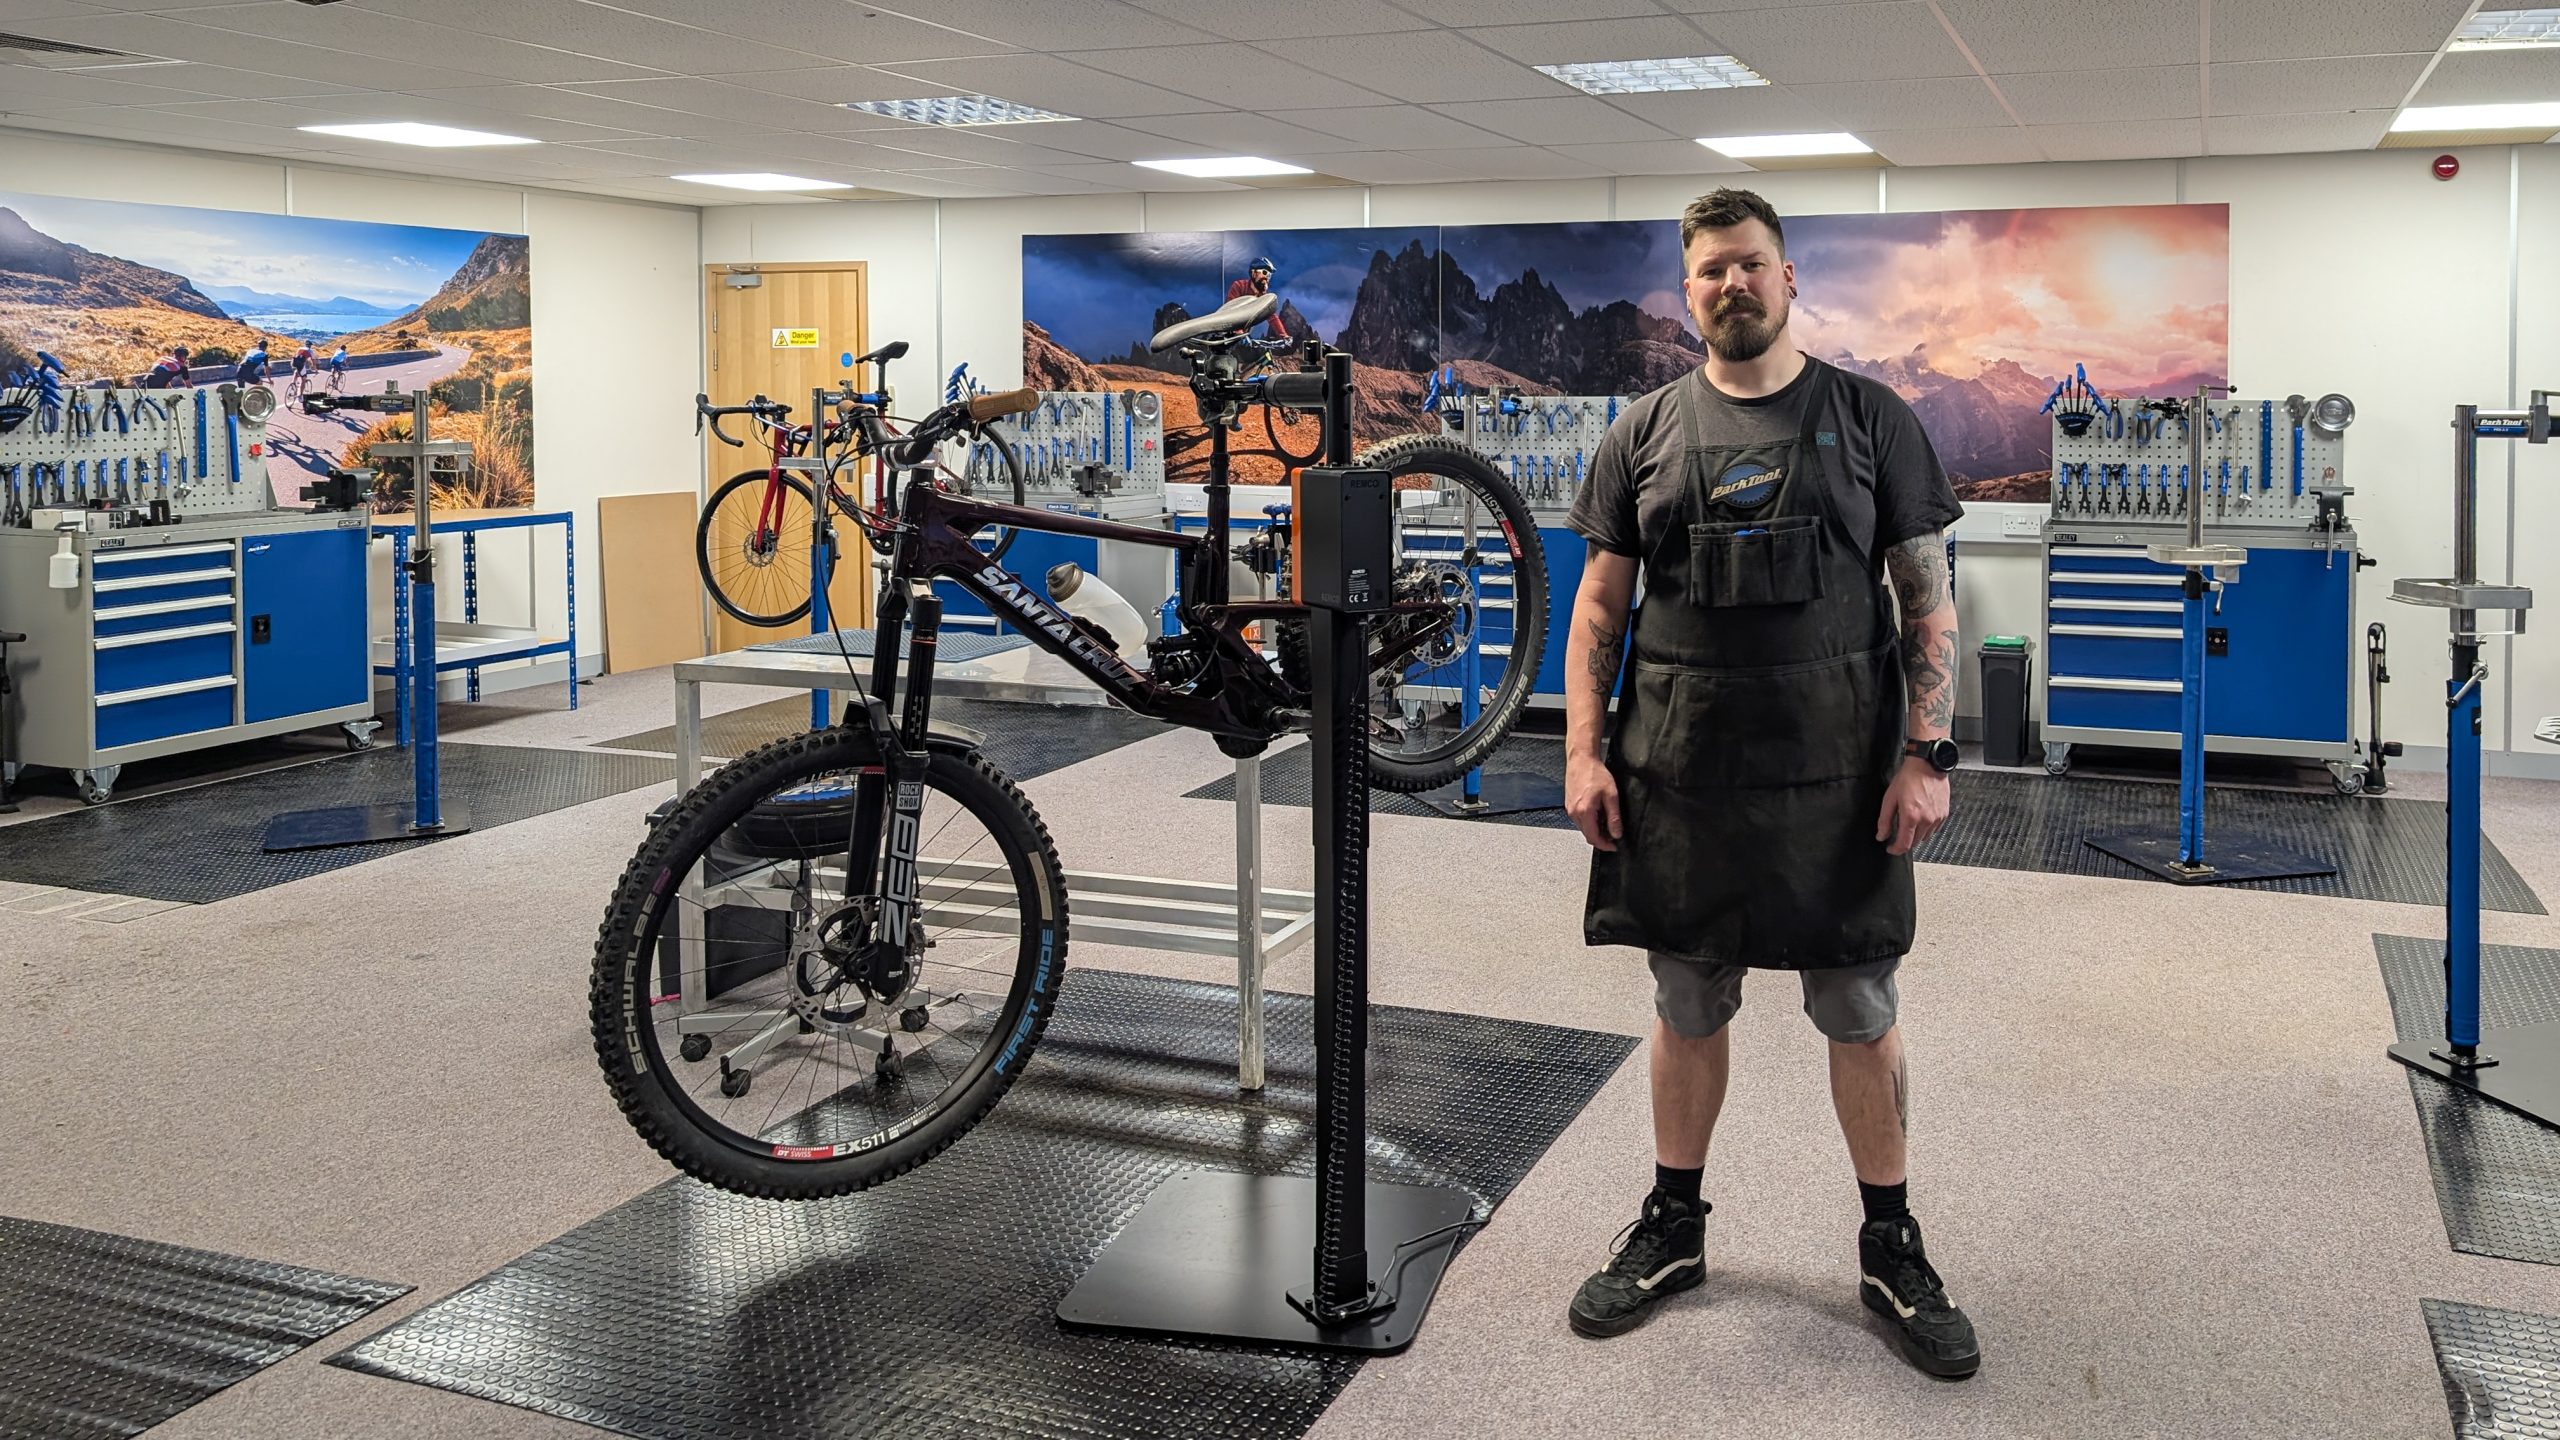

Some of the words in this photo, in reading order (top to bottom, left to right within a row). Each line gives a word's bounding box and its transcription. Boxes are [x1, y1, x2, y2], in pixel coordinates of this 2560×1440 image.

[792, 331, 815, 340] Danger
[1350, 480, 1380, 489] REMCO
[973, 566, 1074, 642] SANTA
[1068, 635, 1147, 691] CRUZ
[1454, 673, 1528, 767] SCHWALBE
[900, 783, 920, 796] ROCK
[883, 812, 917, 947] ZEB
[623, 893, 658, 1075] SCHWALBE
[994, 998, 1041, 1076] FIRST
[1034, 928, 1054, 994] RIDE
[790, 1150, 812, 1158] SWISS
[832, 1131, 886, 1157] EX511
